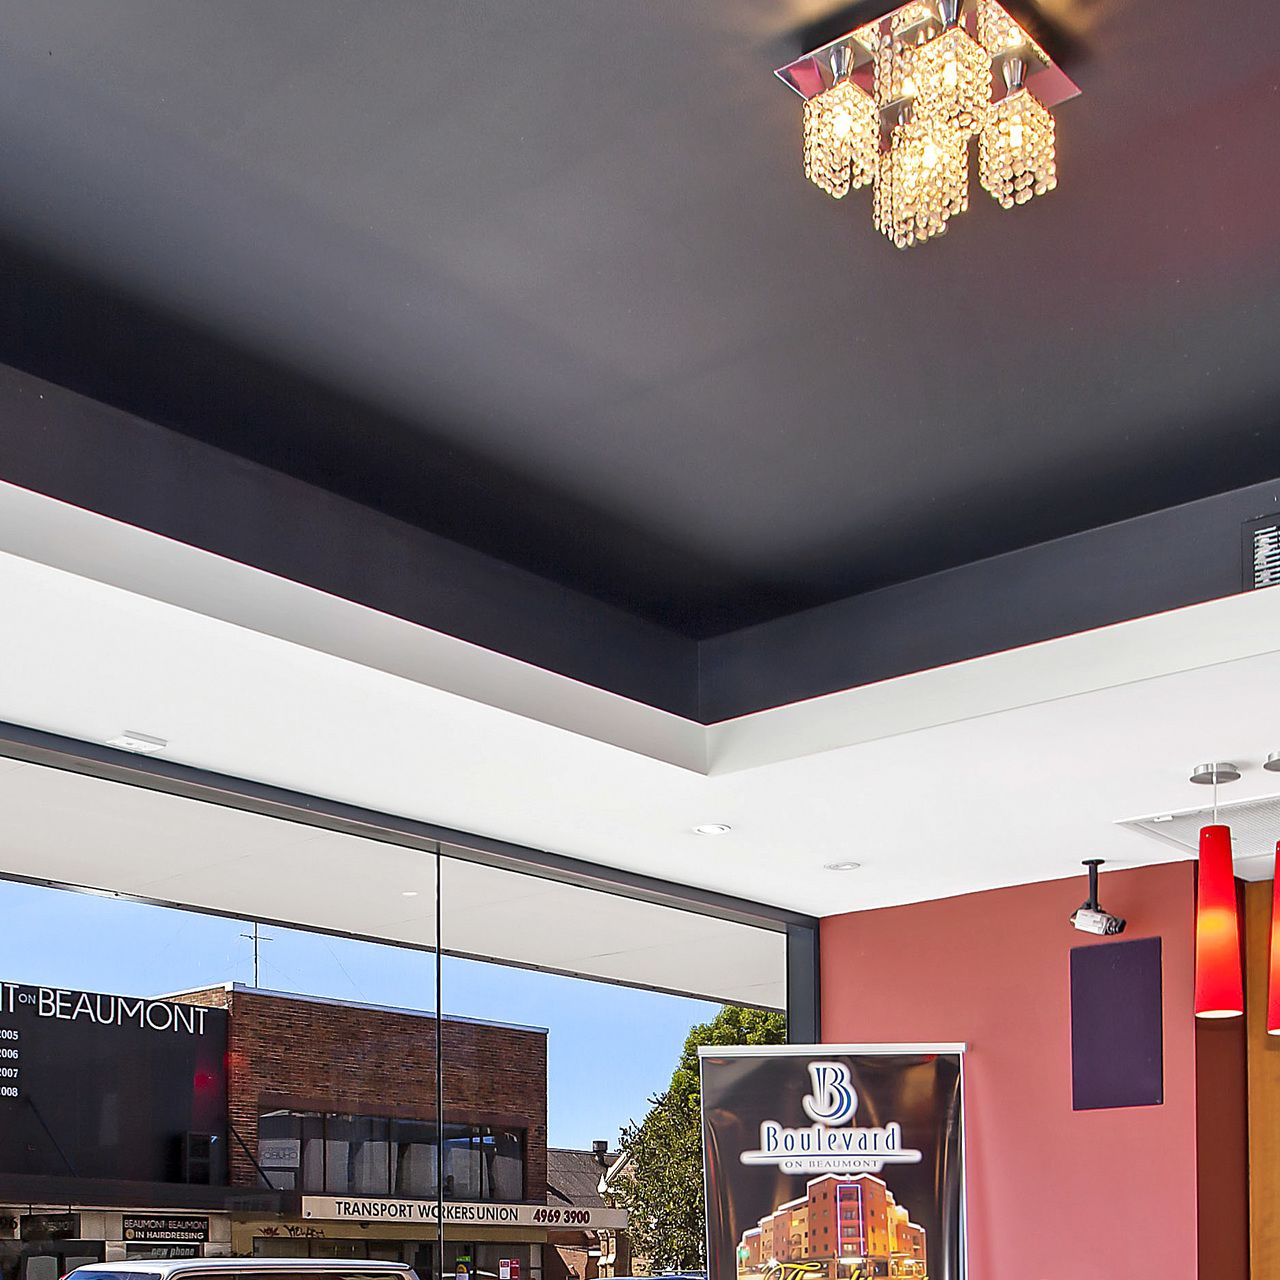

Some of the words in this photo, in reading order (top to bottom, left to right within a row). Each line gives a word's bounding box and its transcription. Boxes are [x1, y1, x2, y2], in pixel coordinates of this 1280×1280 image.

[18, 993, 36, 1005] ON
[38, 987, 209, 1035] BEAUMONT
[766, 1126, 896, 1152] Boulevard
[784, 1160, 803, 1169] ON
[808, 1159, 879, 1169] BEAUMONT
[335, 1201, 414, 1218] TRANSPORT
[476, 1206, 519, 1222] UNION
[533, 1208, 561, 1224] 4969
[563, 1209, 591, 1225] 3900
[135, 1231, 145, 1239] IN
[146, 1231, 205, 1240] HAIRDRESSING
